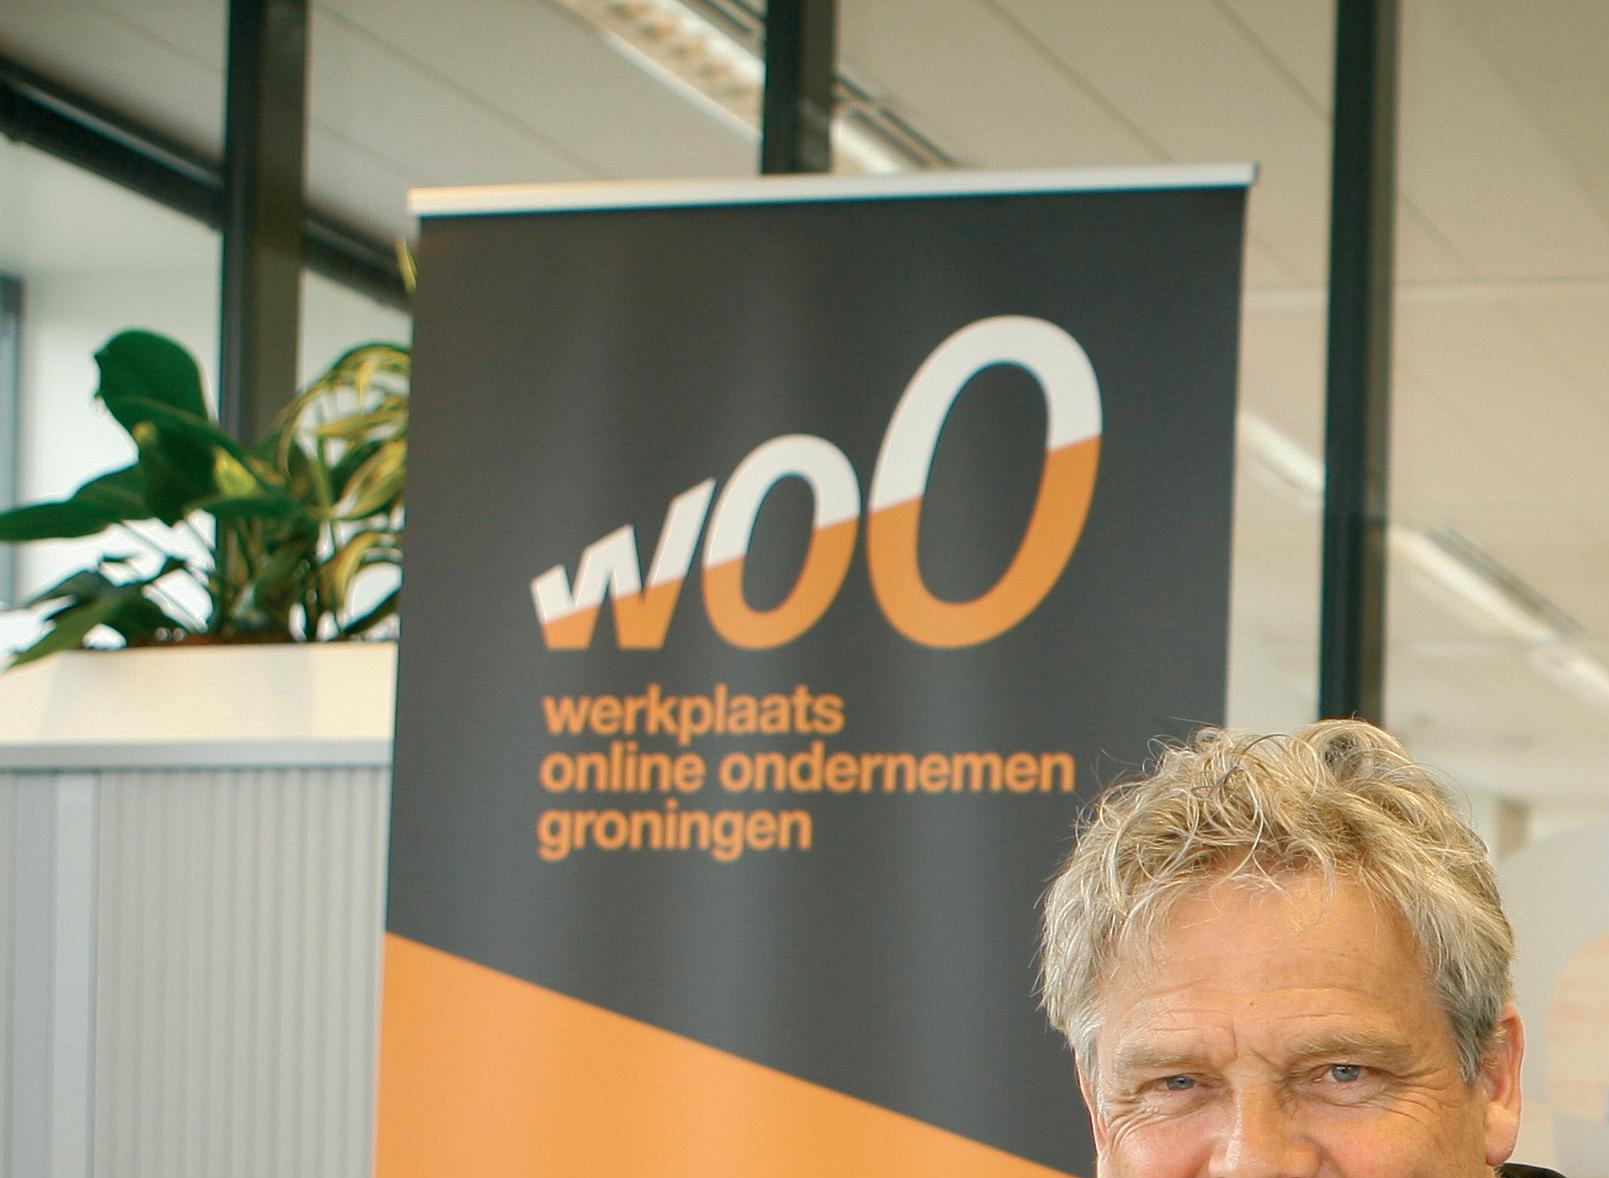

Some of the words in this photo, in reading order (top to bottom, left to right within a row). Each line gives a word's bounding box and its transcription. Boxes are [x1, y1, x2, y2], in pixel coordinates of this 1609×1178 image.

[543, 684, 846, 746] werkplaats
[539, 740, 706, 795] online
[718, 741, 1076, 794] ondernemen
[536, 797, 813, 863] groningen
